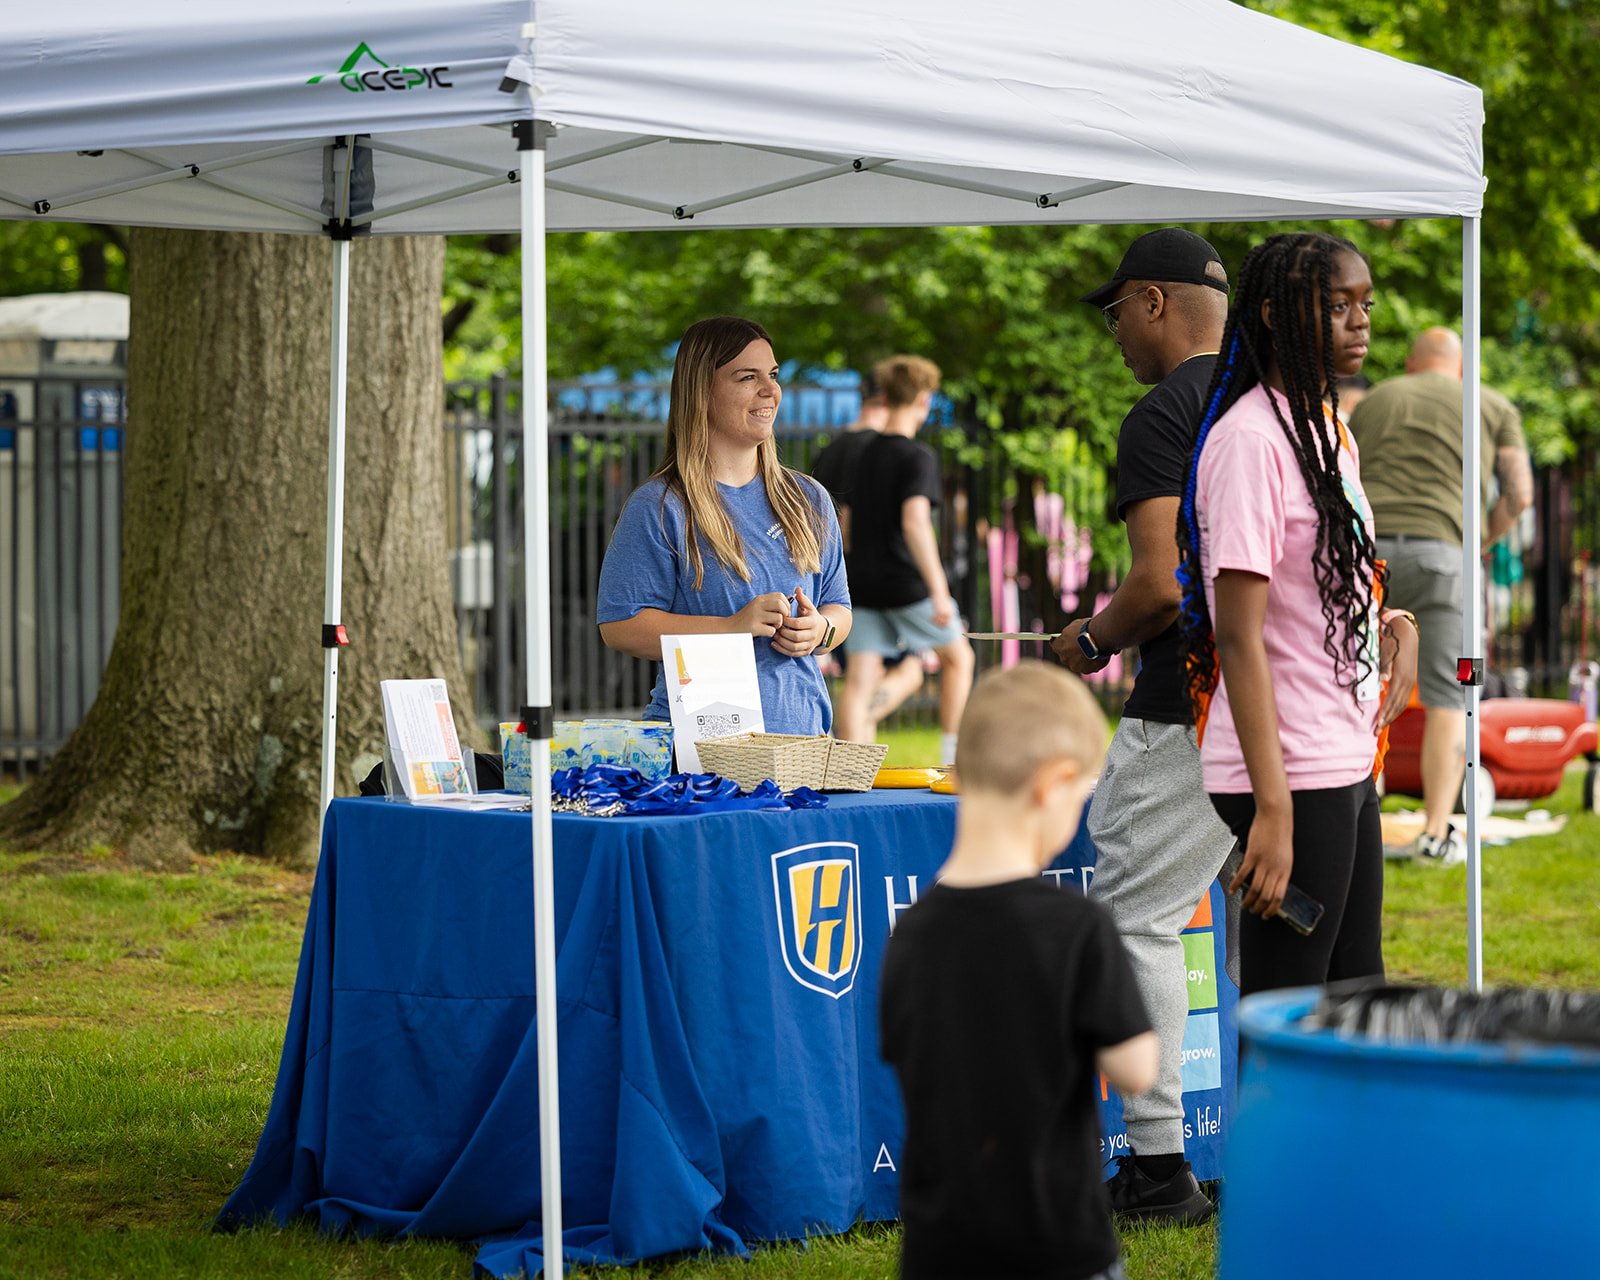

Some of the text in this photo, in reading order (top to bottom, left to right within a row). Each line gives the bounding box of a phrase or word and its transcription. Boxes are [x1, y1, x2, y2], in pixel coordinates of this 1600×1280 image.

[1184, 965, 1208, 986] lay.
[1180, 1047, 1216, 1066] grow.
[1196, 1105, 1221, 1137] life!
